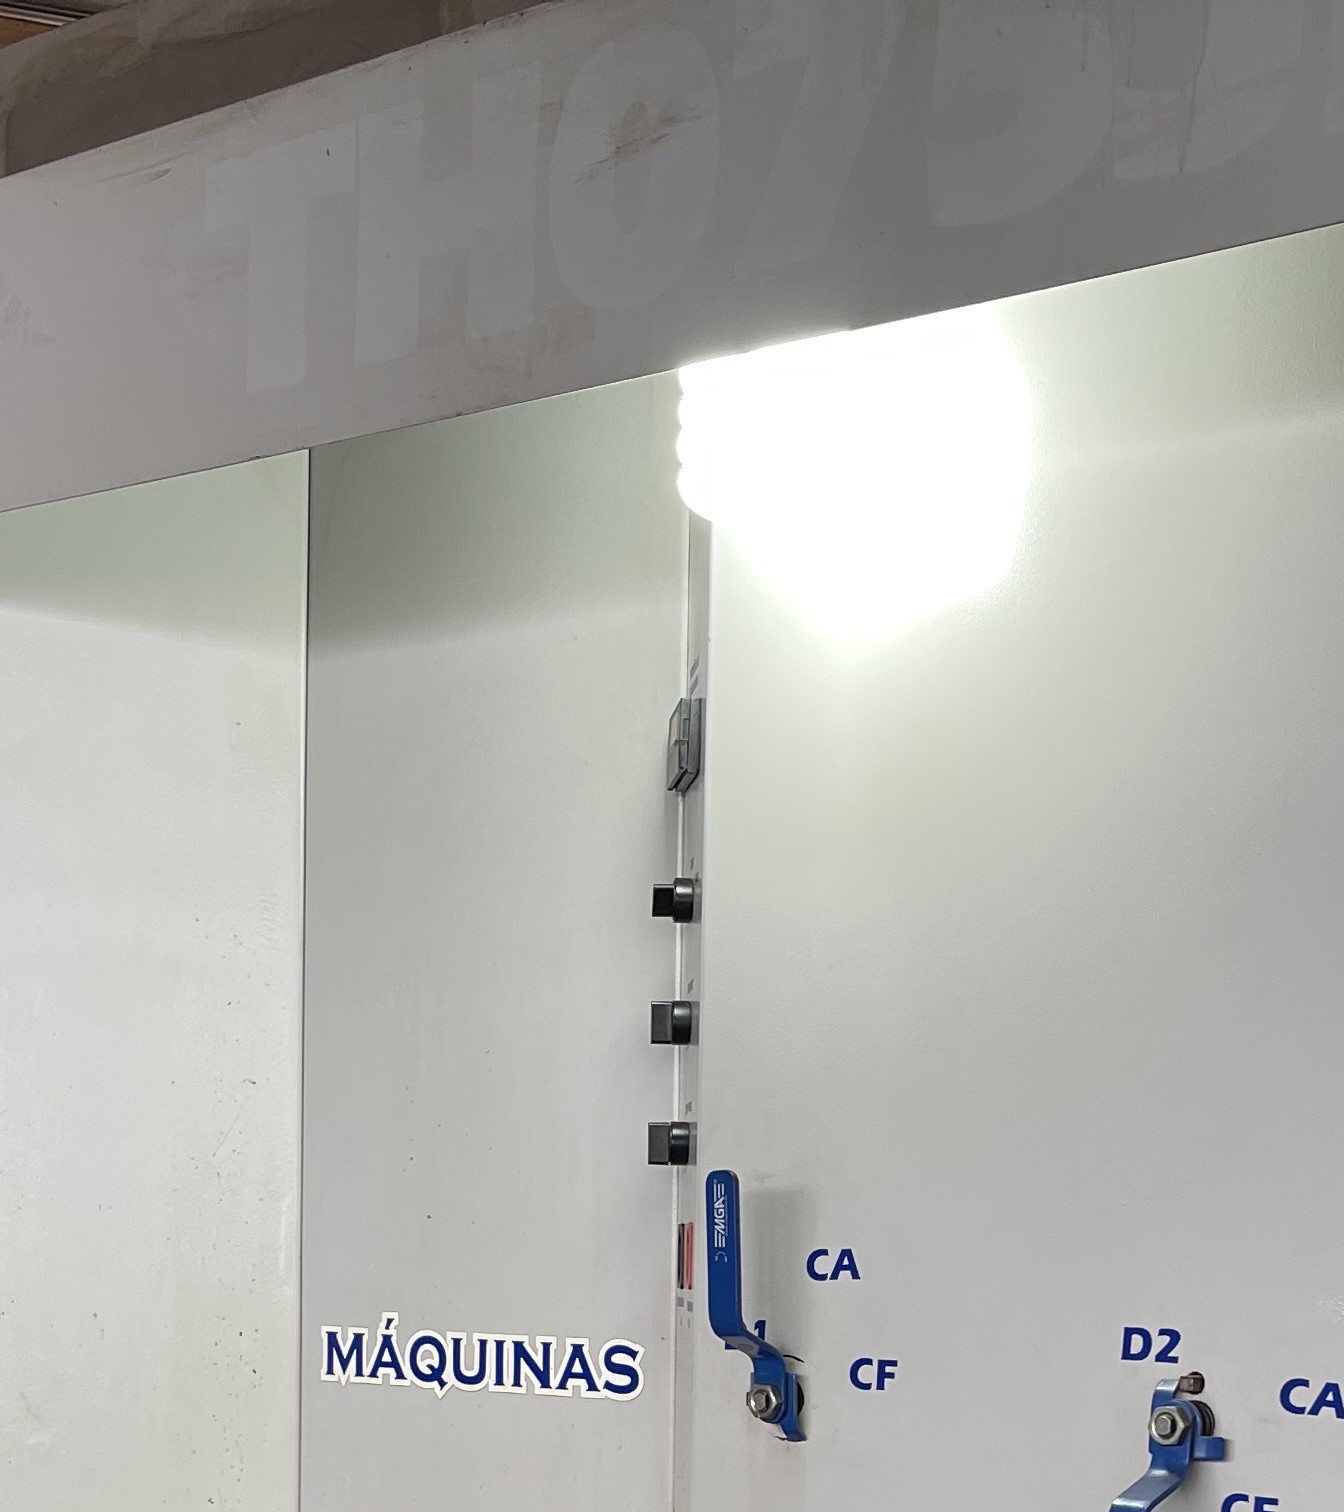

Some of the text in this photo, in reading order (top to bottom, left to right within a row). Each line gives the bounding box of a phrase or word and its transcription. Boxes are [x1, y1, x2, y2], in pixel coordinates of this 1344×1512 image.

[806, 1248, 861, 1281] CA
[325, 1318, 640, 1394] MÁQUINAS
[1121, 1327, 1182, 1363] D2
[849, 1357, 899, 1391] CF
